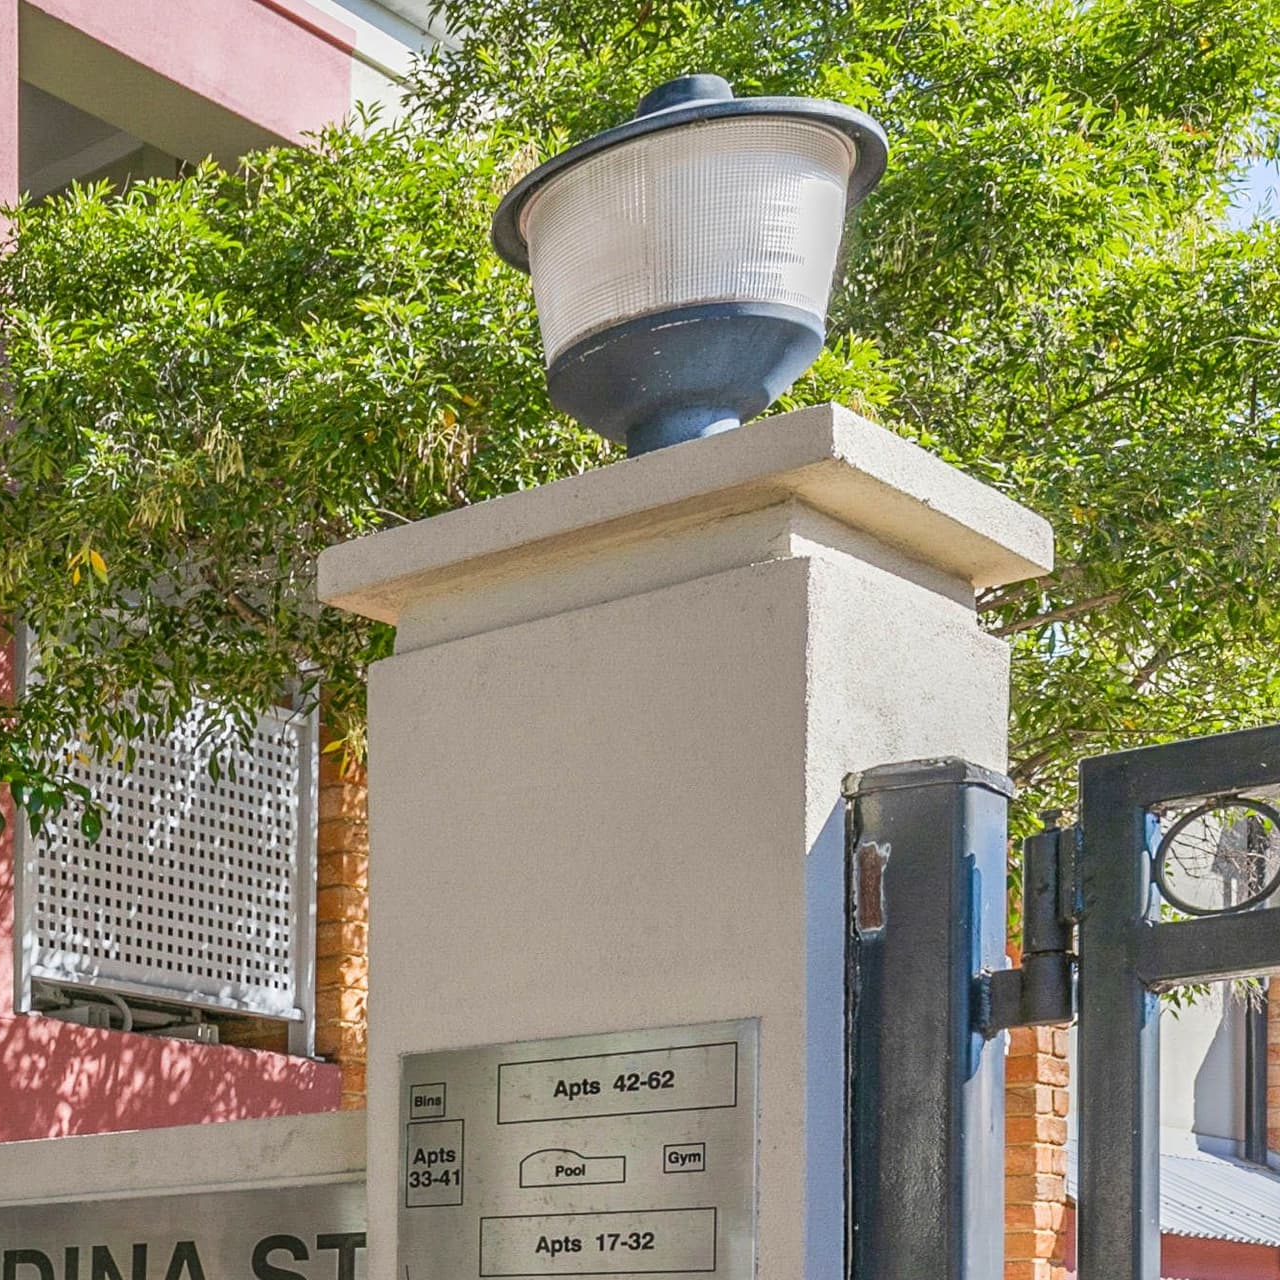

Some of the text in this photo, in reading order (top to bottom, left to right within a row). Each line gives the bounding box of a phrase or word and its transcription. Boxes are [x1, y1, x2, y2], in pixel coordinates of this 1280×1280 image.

[553, 1071, 675, 1101] Apts 42-62
[414, 1094, 442, 1108] Bins
[413, 1147, 456, 1168] Apts
[668, 1150, 701, 1167] Gym
[409, 1169, 461, 1188] 33-41
[555, 1163, 586, 1178] Pool
[535, 1232, 655, 1257] Apts 17-32
